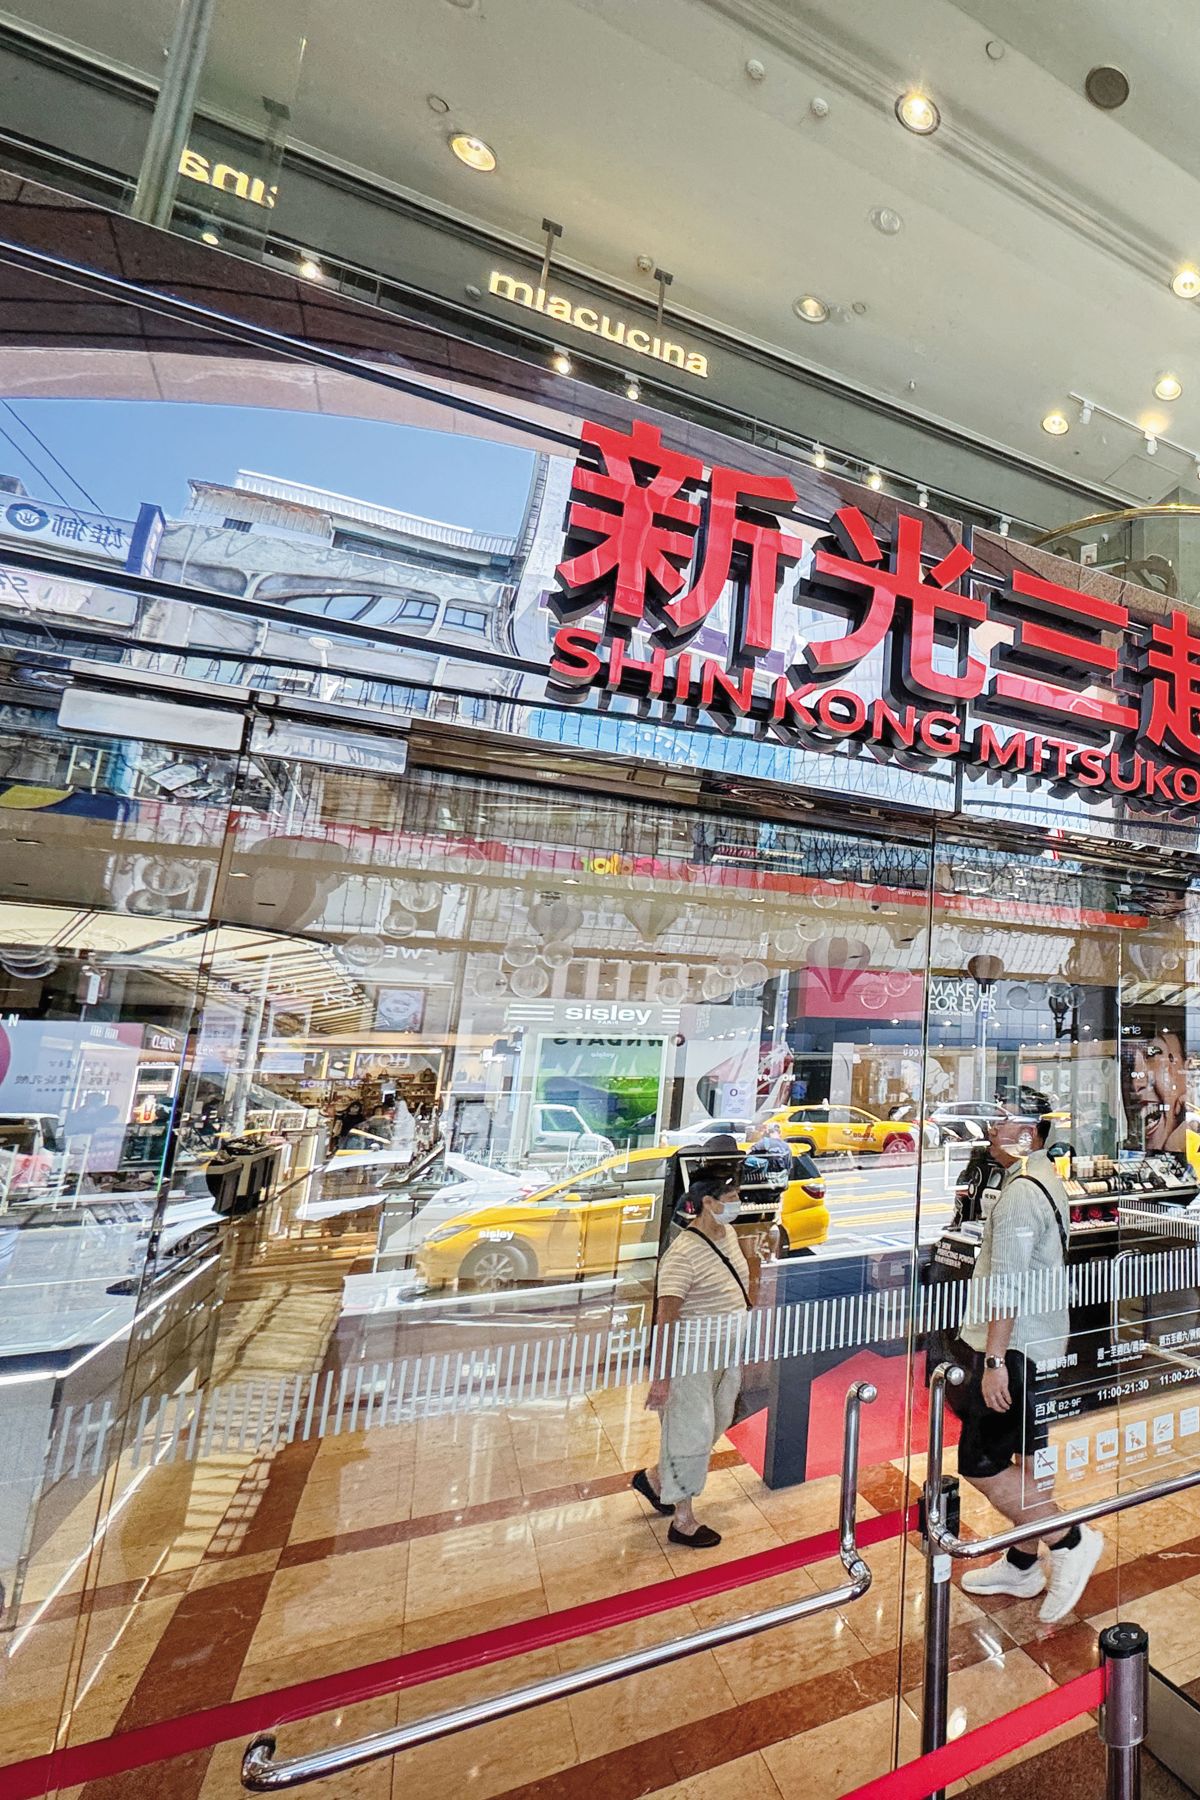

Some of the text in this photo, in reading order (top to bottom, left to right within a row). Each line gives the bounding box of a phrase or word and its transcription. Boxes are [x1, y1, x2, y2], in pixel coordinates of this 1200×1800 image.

[551, 627, 755, 716] SHIN
[773, 674, 963, 756] KONG
[930, 982, 997, 998] MAKE UP
[929, 995, 958, 1011] FOR
[963, 997, 996, 1013] EVER
[565, 1004, 652, 1025] sisley
[478, 1228, 515, 1241] sisley
[1097, 1379, 1149, 1401] 11:00-21:30
[1035, 1397, 1082, 1417] 百貨 B2-9F
